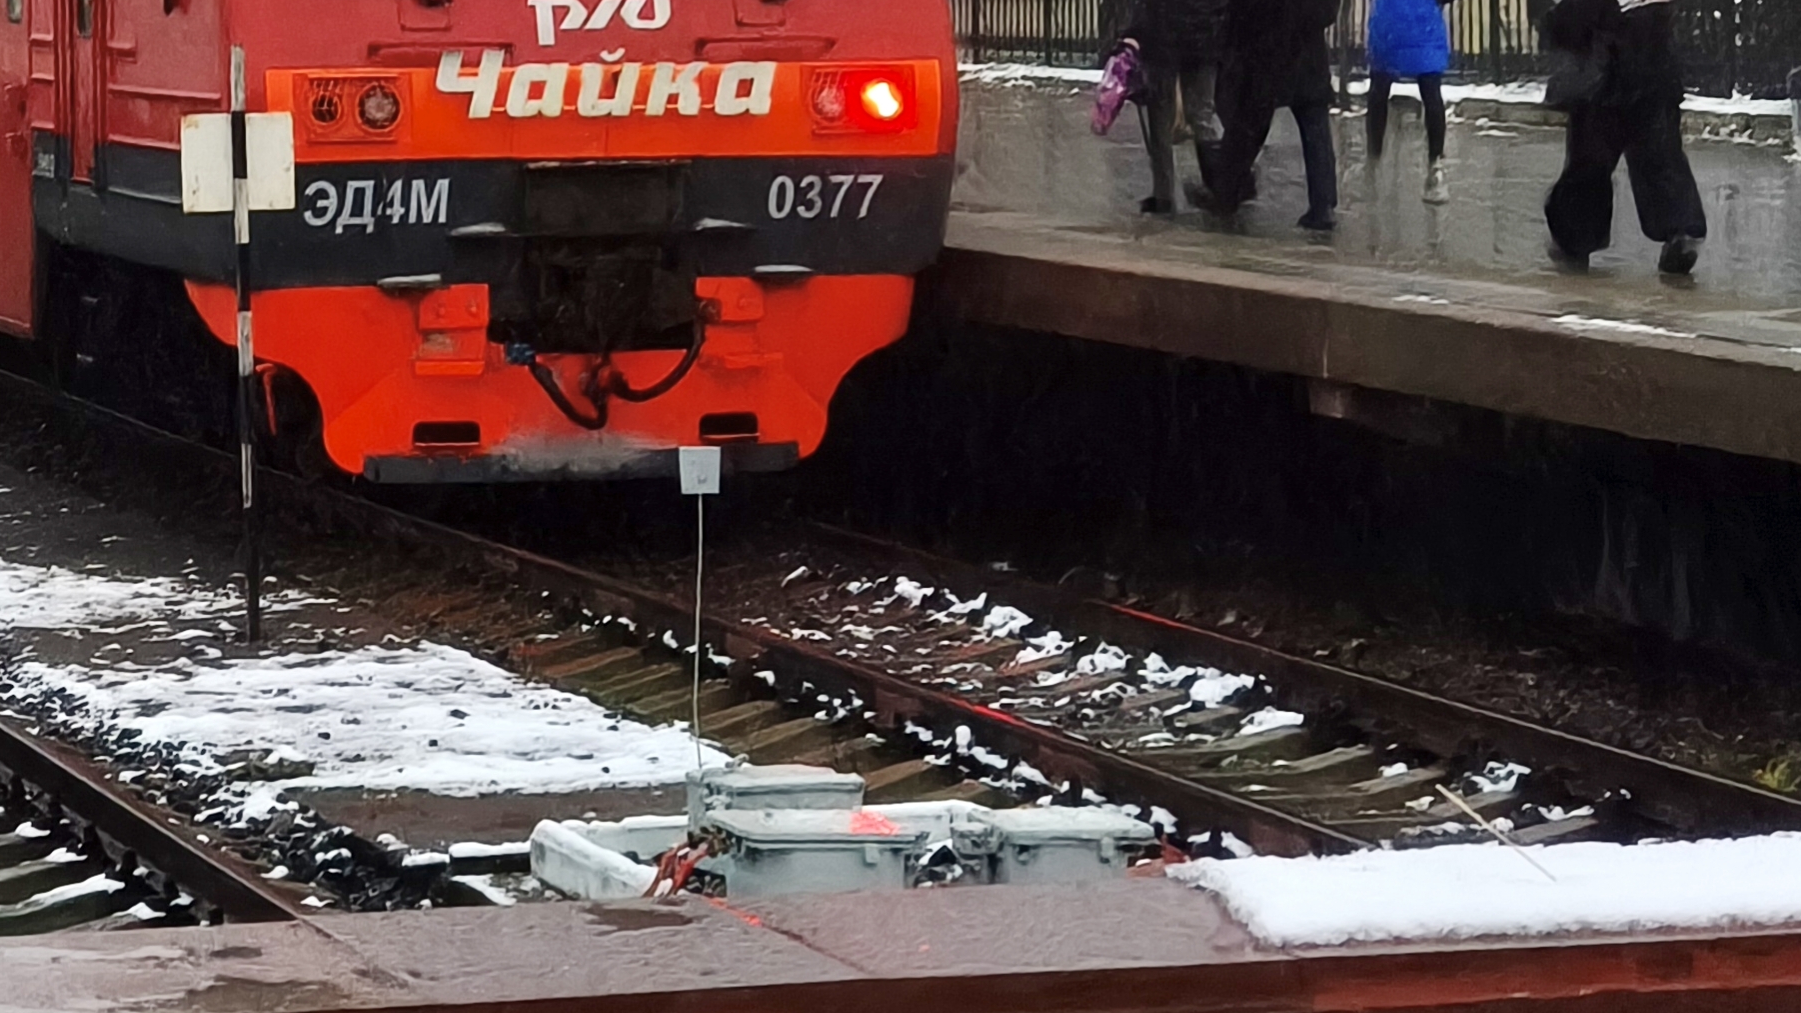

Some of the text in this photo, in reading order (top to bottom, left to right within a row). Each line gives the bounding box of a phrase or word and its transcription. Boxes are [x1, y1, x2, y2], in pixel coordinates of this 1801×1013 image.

[435, 47, 777, 119] Чайка
[303, 178, 451, 234] ЭД4М
[768, 174, 884, 219] 0377
